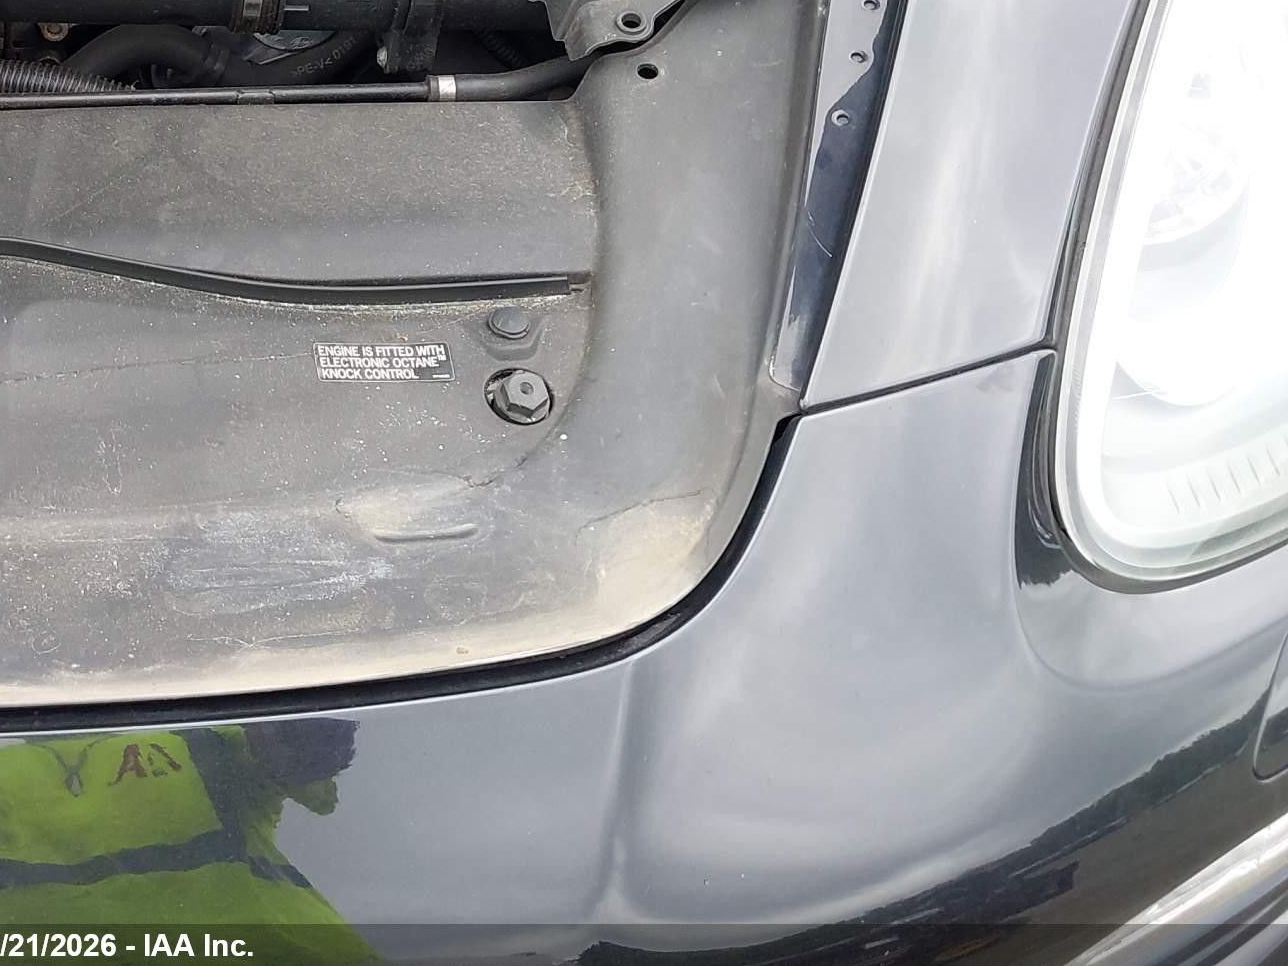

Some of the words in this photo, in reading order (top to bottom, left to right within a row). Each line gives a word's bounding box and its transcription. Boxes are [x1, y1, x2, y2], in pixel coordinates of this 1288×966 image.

[318, 345, 360, 356] ENGINE
[361, 346, 373, 356] IS
[376, 345, 413, 357] FITTED
[416, 345, 445, 355] WITH
[320, 357, 390, 368] ELECTRONIC
[322, 368, 363, 379] KNOCK
[364, 368, 419, 379] CONTROL
